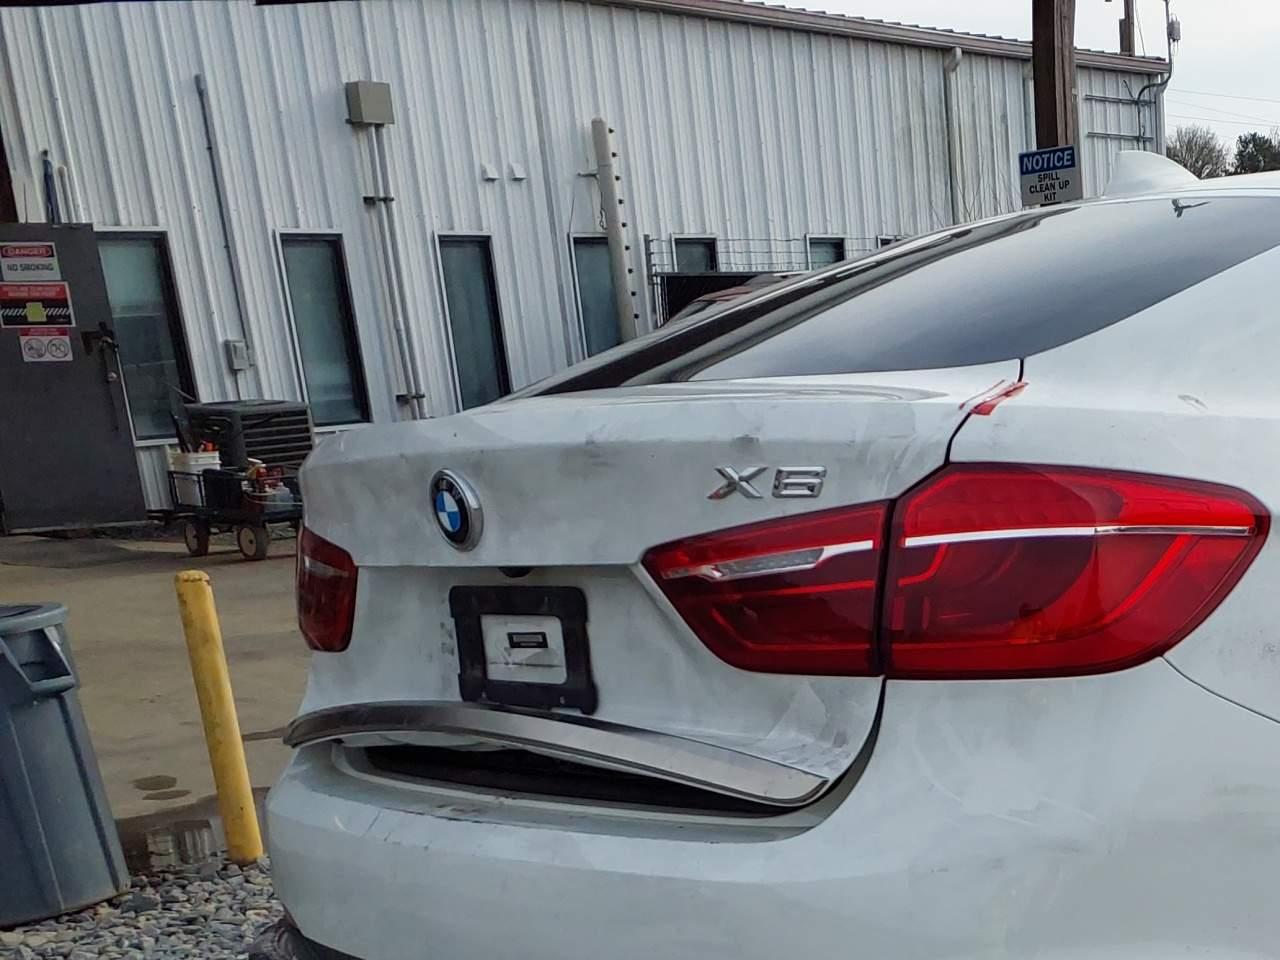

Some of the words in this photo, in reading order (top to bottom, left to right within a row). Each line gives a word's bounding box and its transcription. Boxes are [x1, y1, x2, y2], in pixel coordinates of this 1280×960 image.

[1023, 150, 1073, 172] NOTICE
[1038, 172, 1060, 183] SPILL
[1029, 182, 1056, 194] CLEAN
[1058, 180, 1070, 190] UP
[1044, 192, 1056, 202] KIT
[8, 247, 46, 256] DANGER
[7, 263, 18, 272] NO
[20, 263, 54, 272] SMOKING
[707, 465, 828, 499] X6
